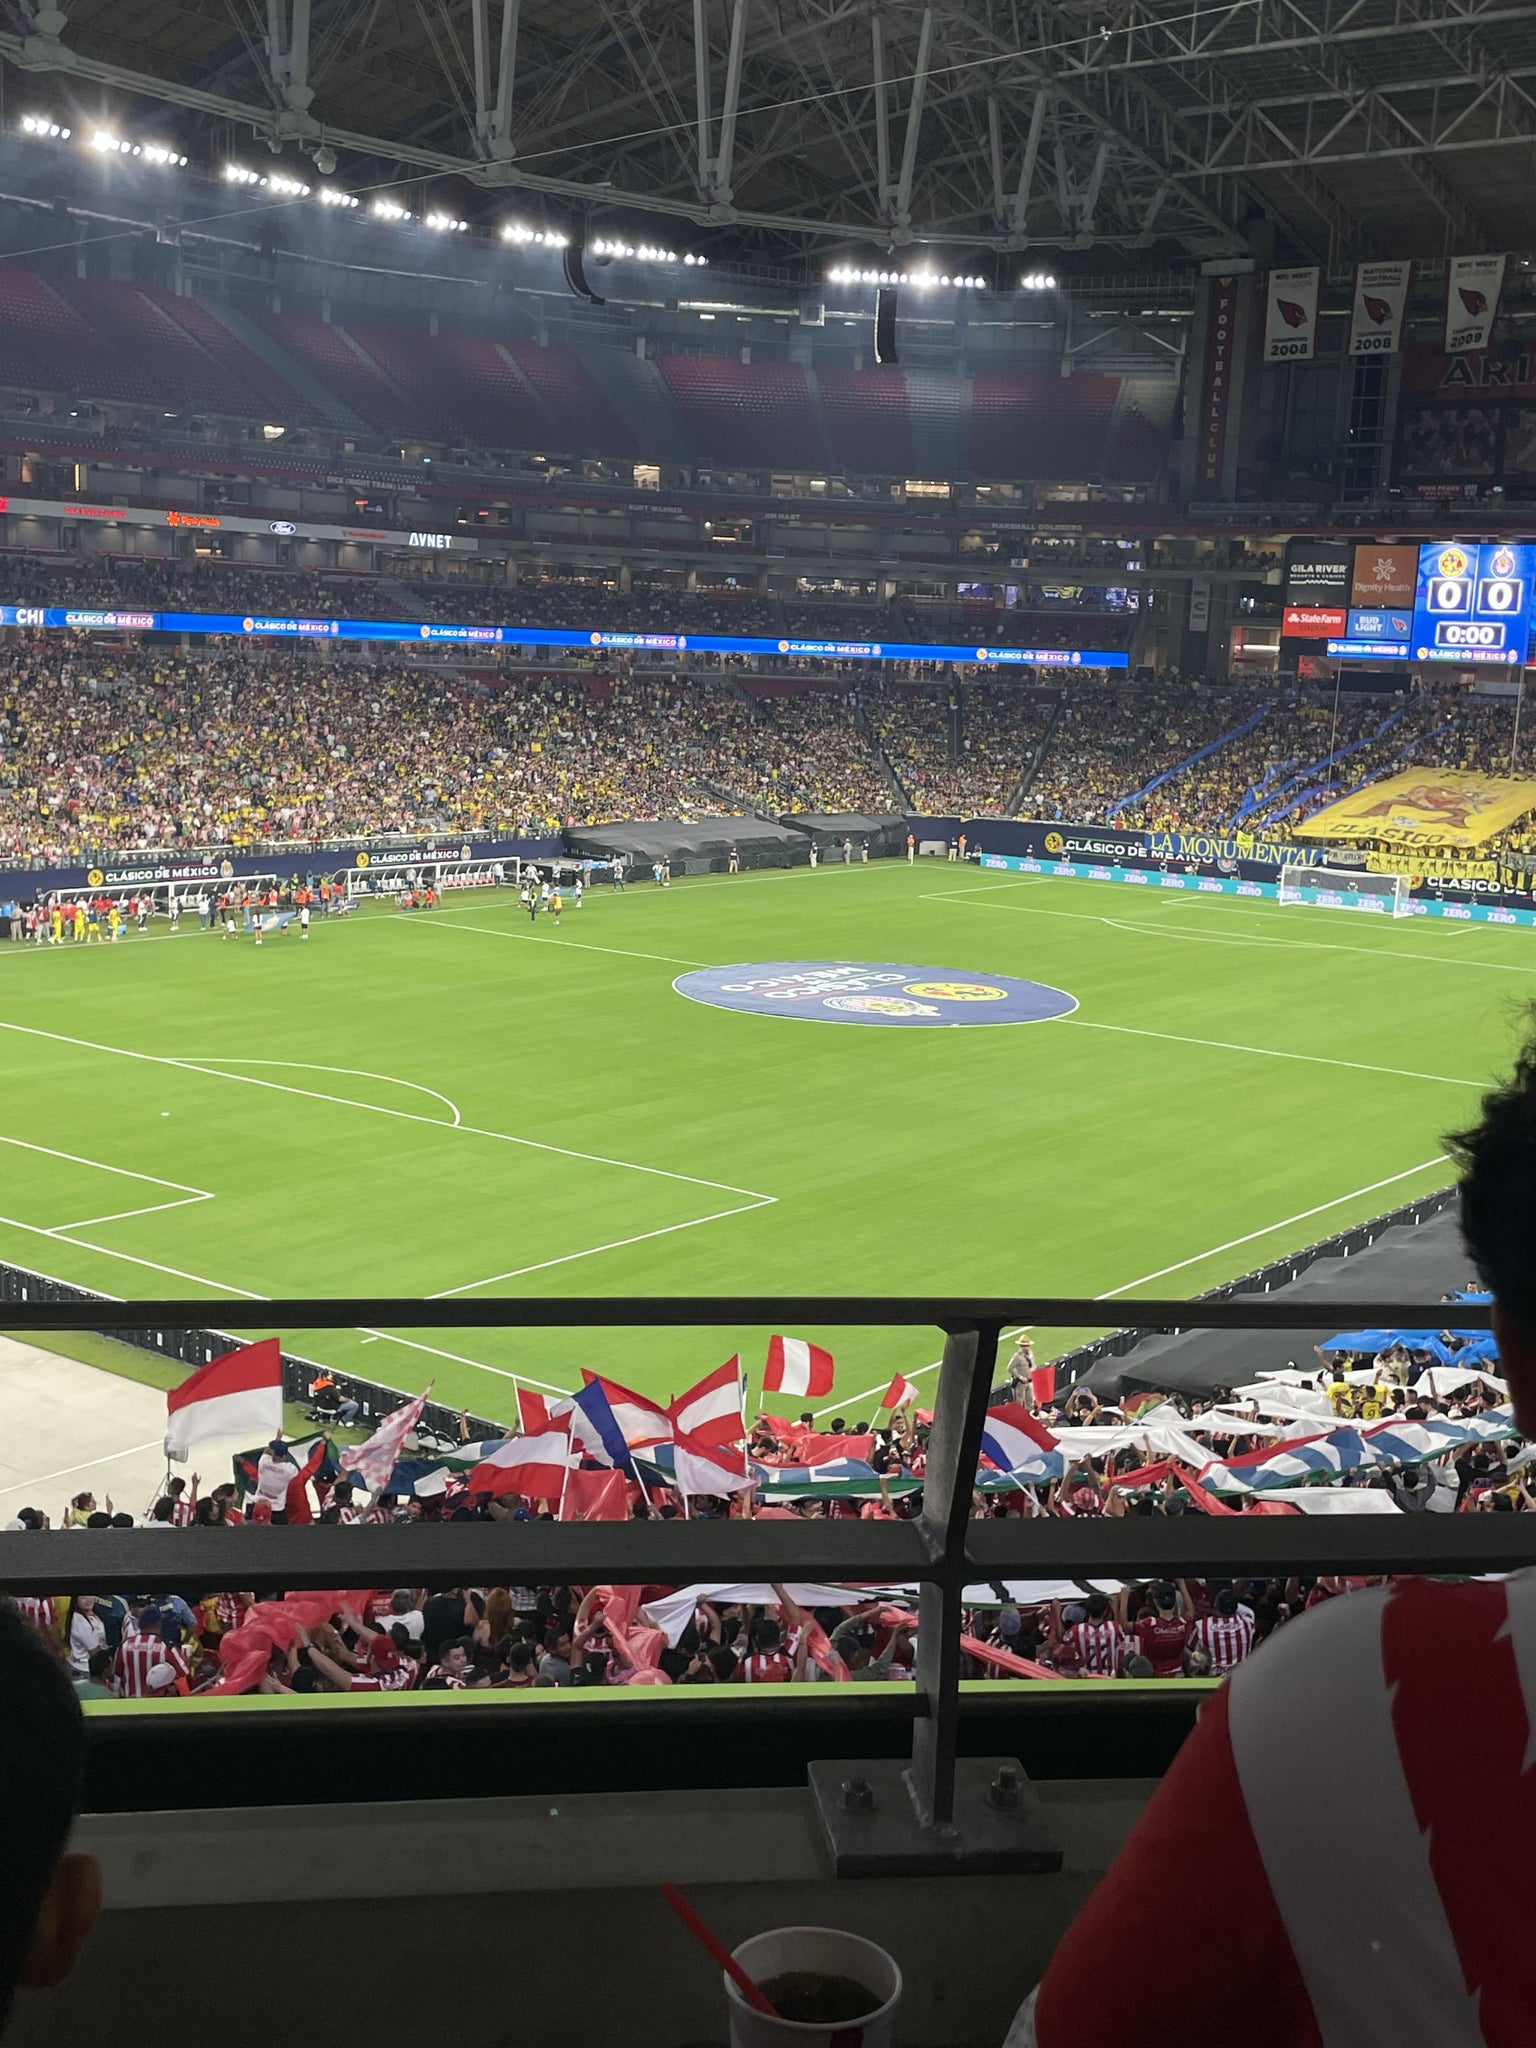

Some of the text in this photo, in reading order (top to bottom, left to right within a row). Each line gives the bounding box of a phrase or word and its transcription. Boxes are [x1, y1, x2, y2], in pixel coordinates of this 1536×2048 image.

[1355, 337, 1391, 350] 2008
[1451, 332, 1482, 347] 2009
[1270, 344, 1308, 356] 2008
[1438, 354, 1536, 388] ARI
[1206, 298, 1229, 479] FOOTBALL CLUB
[409, 533, 452, 548] AVNET
[1290, 564, 1346, 573] GILA RIVER
[1355, 583, 1411, 593] Dignity Health
[1437, 581, 1461, 609] 0
[1488, 582, 1513, 610] 0
[16, 608, 44, 624] CHI
[1359, 616, 1380, 624] BUD
[1355, 624, 1383, 632] LIGHT
[1446, 626, 1494, 644] 0:00
[1065, 840, 1125, 855] CLÁSICO
[1127, 846, 1148, 857] DE
[1151, 834, 1173, 852] LA
[1180, 836, 1318, 867] MONUMENTAL
[370, 853, 408, 864] CLÁSICO
[423, 850, 459, 860] MÉXICO
[985, 859, 1008, 869] ZERO
[1019, 862, 1041, 872] ZERO
[105, 870, 153, 882] CLÁSICO
[172, 866, 218, 878] MÉXICO
[1053, 866, 1076, 876] ZERO
[1088, 870, 1111, 880] ZERO
[1124, 873, 1148, 884] ZERO
[1160, 877, 1185, 888] ZERO
[1198, 881, 1223, 892] ZERO
[1236, 885, 1262, 896] ZERO
[1443, 907, 1471, 919] ZERO
[1486, 911, 1516, 924] ZERO
